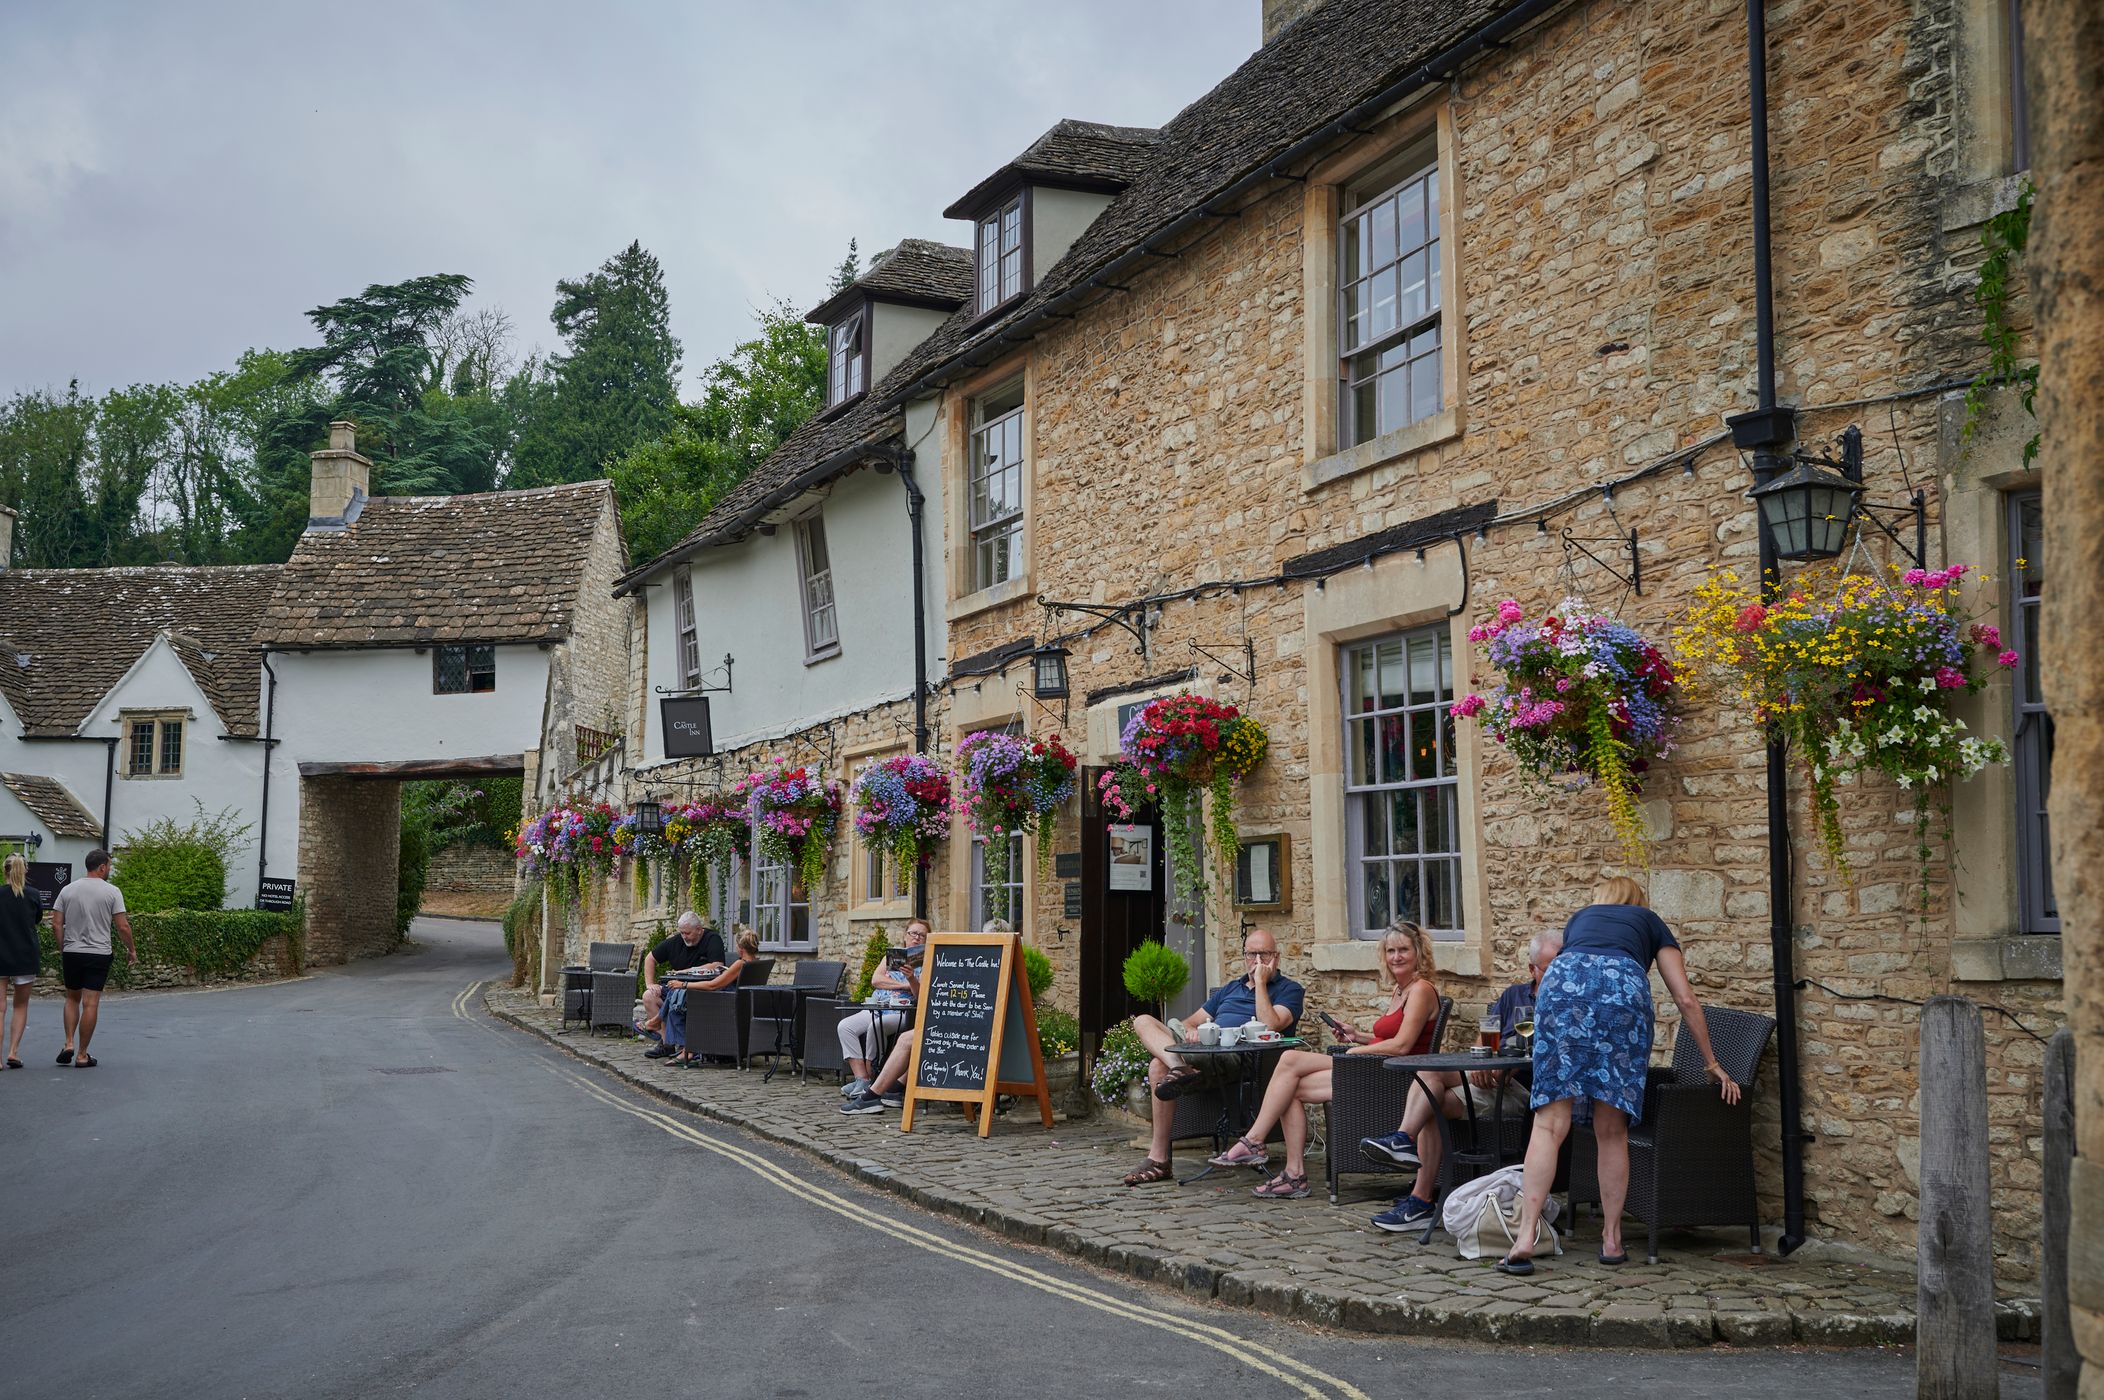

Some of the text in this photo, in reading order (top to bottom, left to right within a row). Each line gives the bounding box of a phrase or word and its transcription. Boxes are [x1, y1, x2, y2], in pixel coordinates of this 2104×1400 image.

[262, 882, 292, 892] PRIVATE
[936, 952, 957, 968] Welcome
[958, 958, 965, 968] to
[964, 957, 975, 968] The
[974, 955, 990, 968] Castle
[931, 976, 948, 988] Lunch
[935, 987, 949, 998] from
[970, 989, 986, 999] Please
[948, 1000, 956, 1008] the
[968, 1001, 974, 1009] to
[974, 1001, 982, 1010] be
[932, 1009, 941, 1019] by
[927, 1025, 943, 1038] Tables
[961, 1033, 970, 1041] are
[970, 1032, 979, 1041] for
[952, 1040, 967, 1049] Please
[927, 1046, 936, 1054] the
